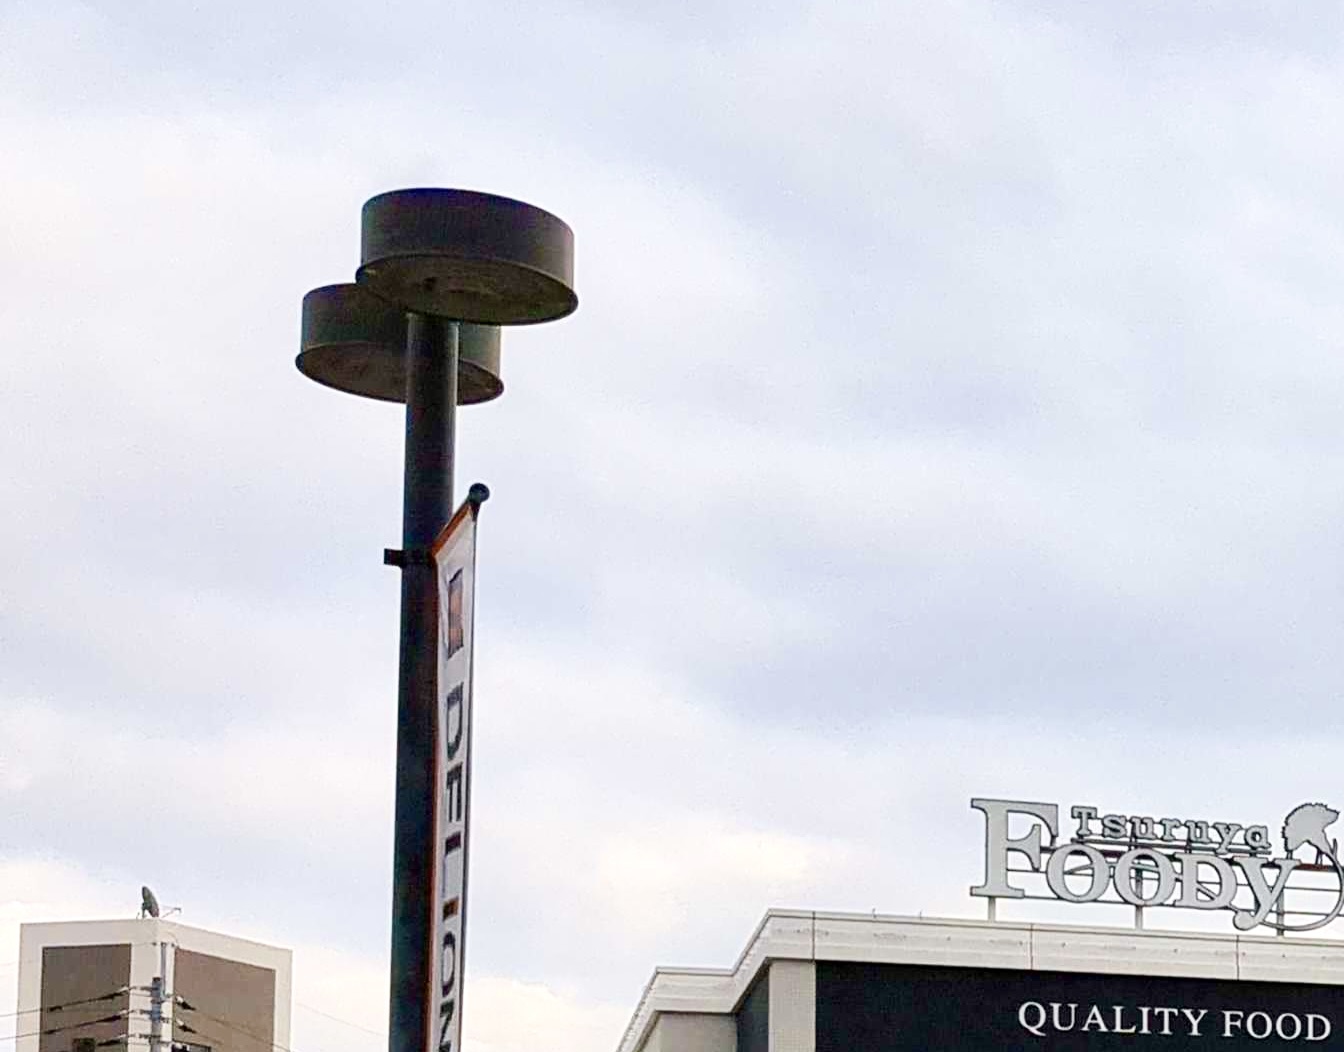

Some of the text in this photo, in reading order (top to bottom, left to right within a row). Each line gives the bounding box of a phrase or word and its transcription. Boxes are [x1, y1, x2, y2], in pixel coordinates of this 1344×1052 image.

[1070, 805, 1272, 853] Tsuruya
[1018, 1001, 1209, 1036] QUALITY
[1221, 1010, 1332, 1041] FOOD
